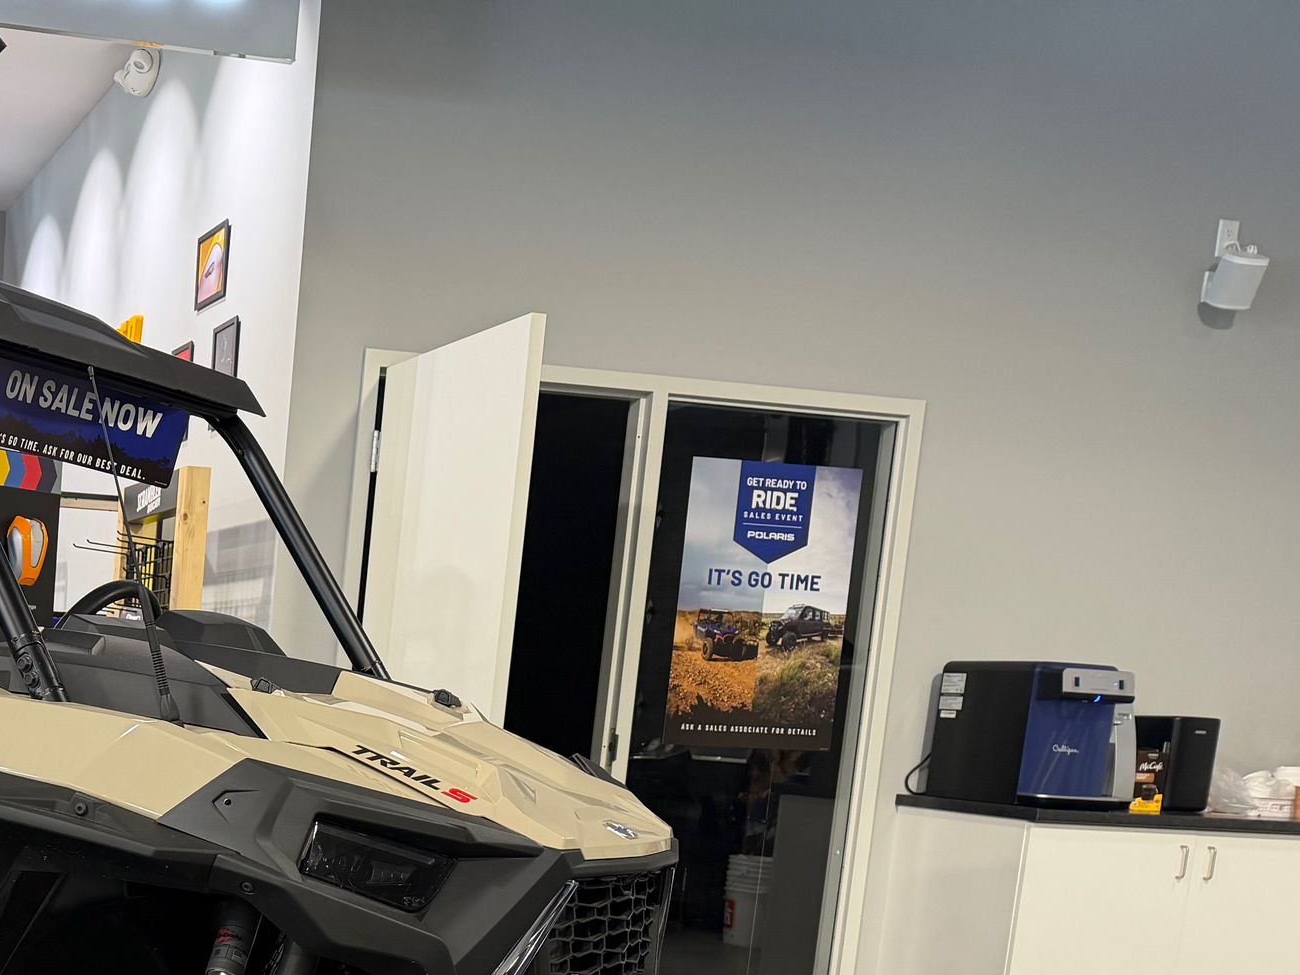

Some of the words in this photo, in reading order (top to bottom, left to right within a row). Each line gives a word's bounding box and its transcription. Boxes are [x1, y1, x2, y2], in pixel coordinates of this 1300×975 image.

[6, 369, 39, 404] ON
[38, 379, 98, 421] SALE
[98, 397, 163, 439] NOW
[8, 435, 17, 447] GO
[20, 438, 40, 453] TIME.
[42, 444, 58, 456] ASK
[59, 448, 75, 461] FOR
[76, 453, 92, 465] OUR
[120, 464, 146, 480] DEAL.
[746, 477, 765, 487] GET
[765, 478, 795, 489] READY
[796, 480, 807, 490] TO
[751, 489, 799, 512] RIDE
[743, 511, 771, 520] SALES
[775, 513, 803, 522] EVENT
[747, 530, 795, 542] POLARIS
[707, 568, 743, 587] IT'S
[747, 570, 772, 589] GO
[778, 573, 822, 592] TIME
[680, 723, 694, 731] ASK
[705, 724, 727, 732] SALES
[730, 725, 768, 734] ASSOCIATE
[771, 727, 785, 735] FOR
[787, 728, 817, 736] DETAILS
[352, 744, 441, 790] TRAIL
[441, 788, 478, 803] S
